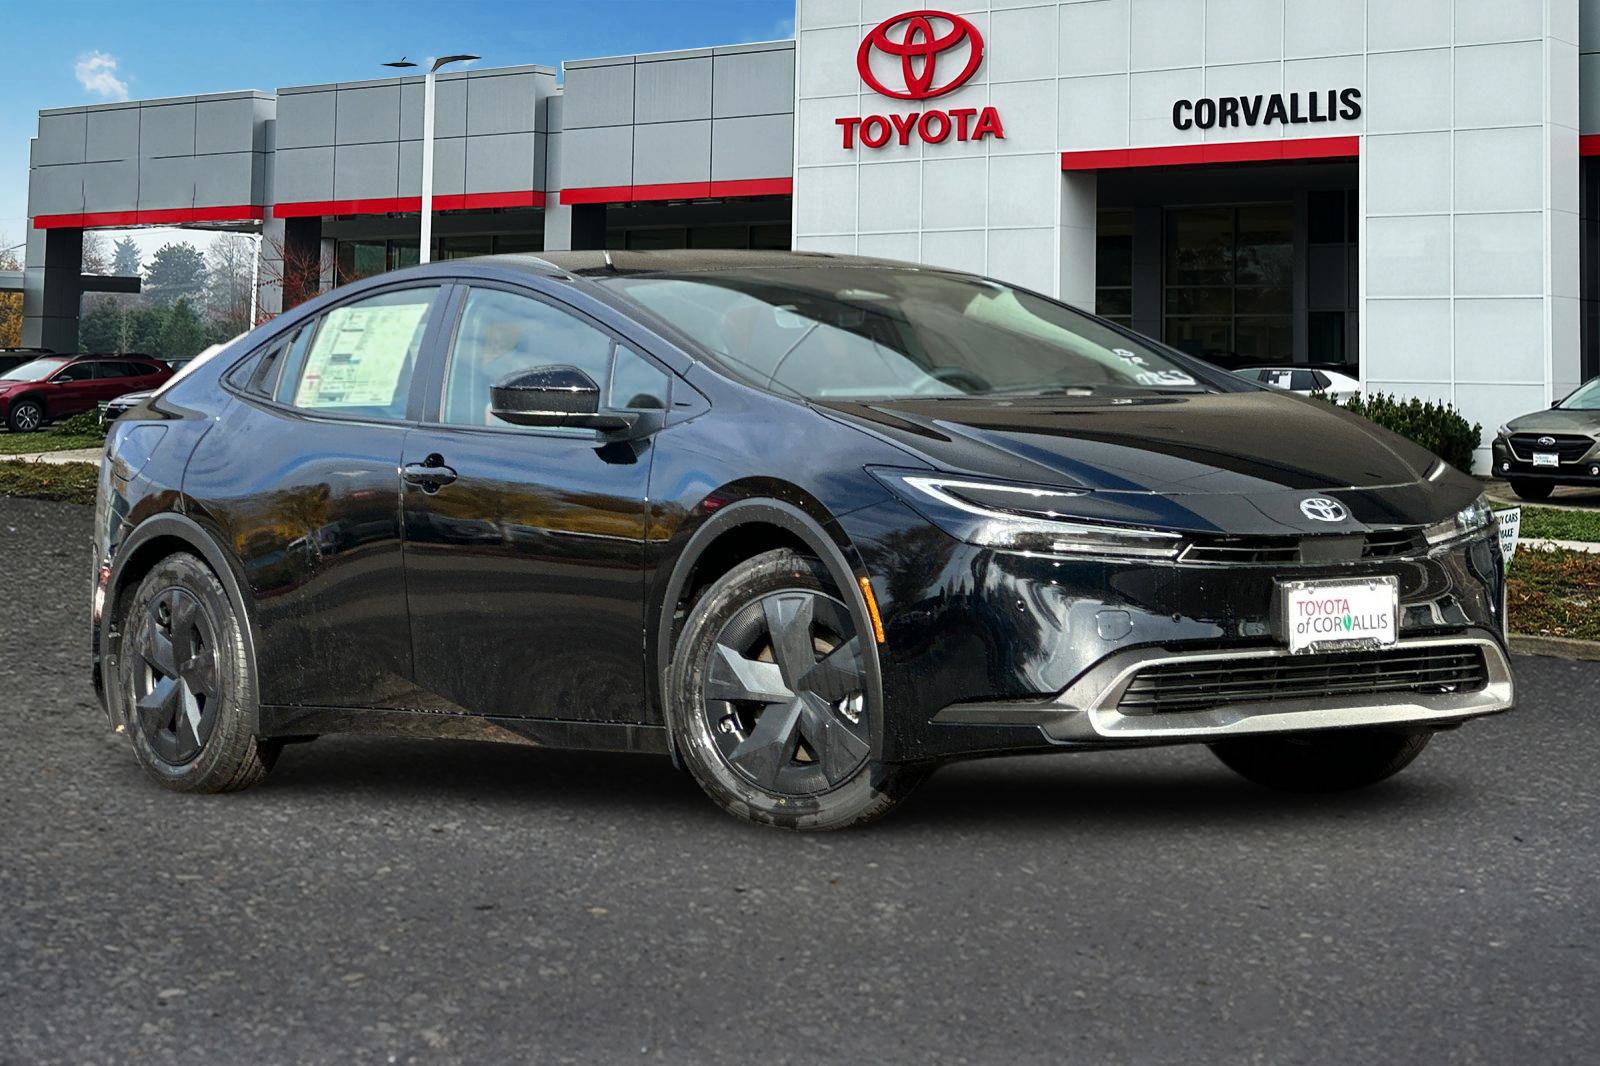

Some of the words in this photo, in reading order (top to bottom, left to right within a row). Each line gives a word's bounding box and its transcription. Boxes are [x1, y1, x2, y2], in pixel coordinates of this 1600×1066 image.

[1172, 87, 1362, 131] CORVALLIS
[835, 106, 1006, 149] TOYOTA
[1296, 599, 1351, 617] TOYOTA
[1297, 617, 1311, 634] of
[1313, 613, 1388, 633] CORVALLIS
